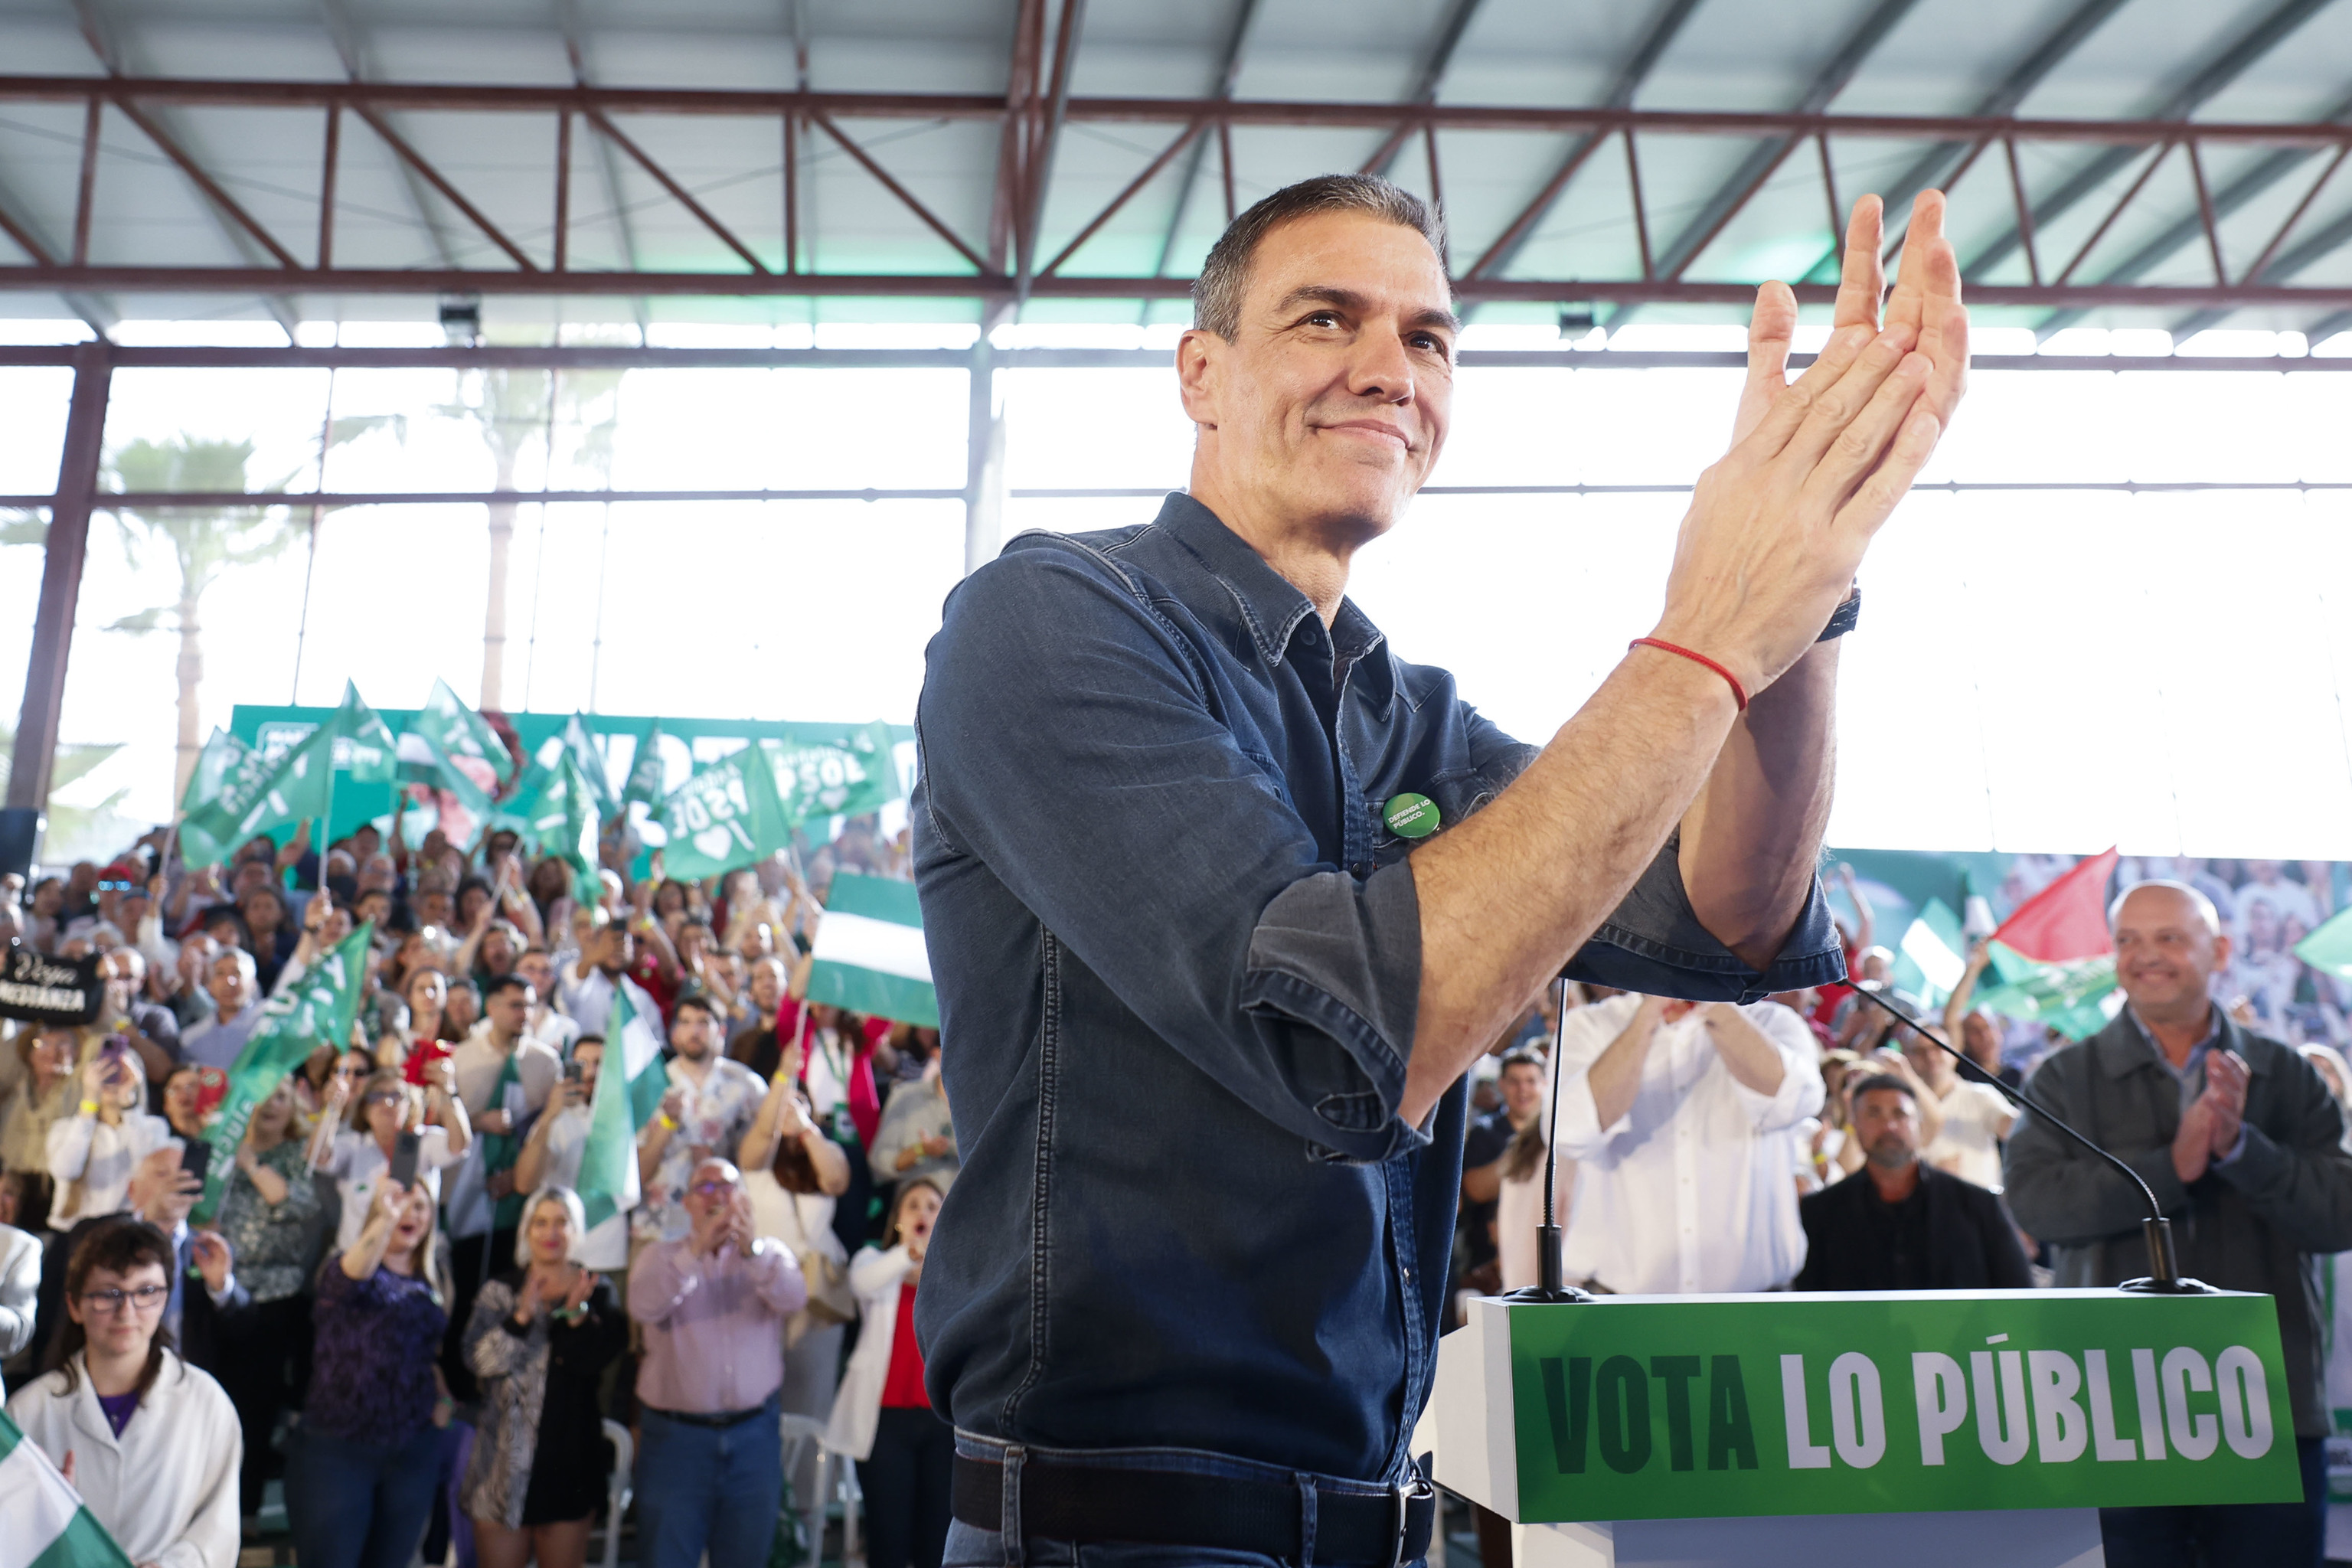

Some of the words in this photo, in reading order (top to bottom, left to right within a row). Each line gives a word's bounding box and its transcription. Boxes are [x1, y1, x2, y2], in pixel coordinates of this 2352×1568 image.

[1388, 803, 1421, 824] DEFIENDE
[1419, 799, 1431, 808] LO
[1540, 1354, 1759, 1474] VOTA
[1780, 1351, 1886, 1469] LO
[1911, 1333, 2274, 1465] PÚBLICO
